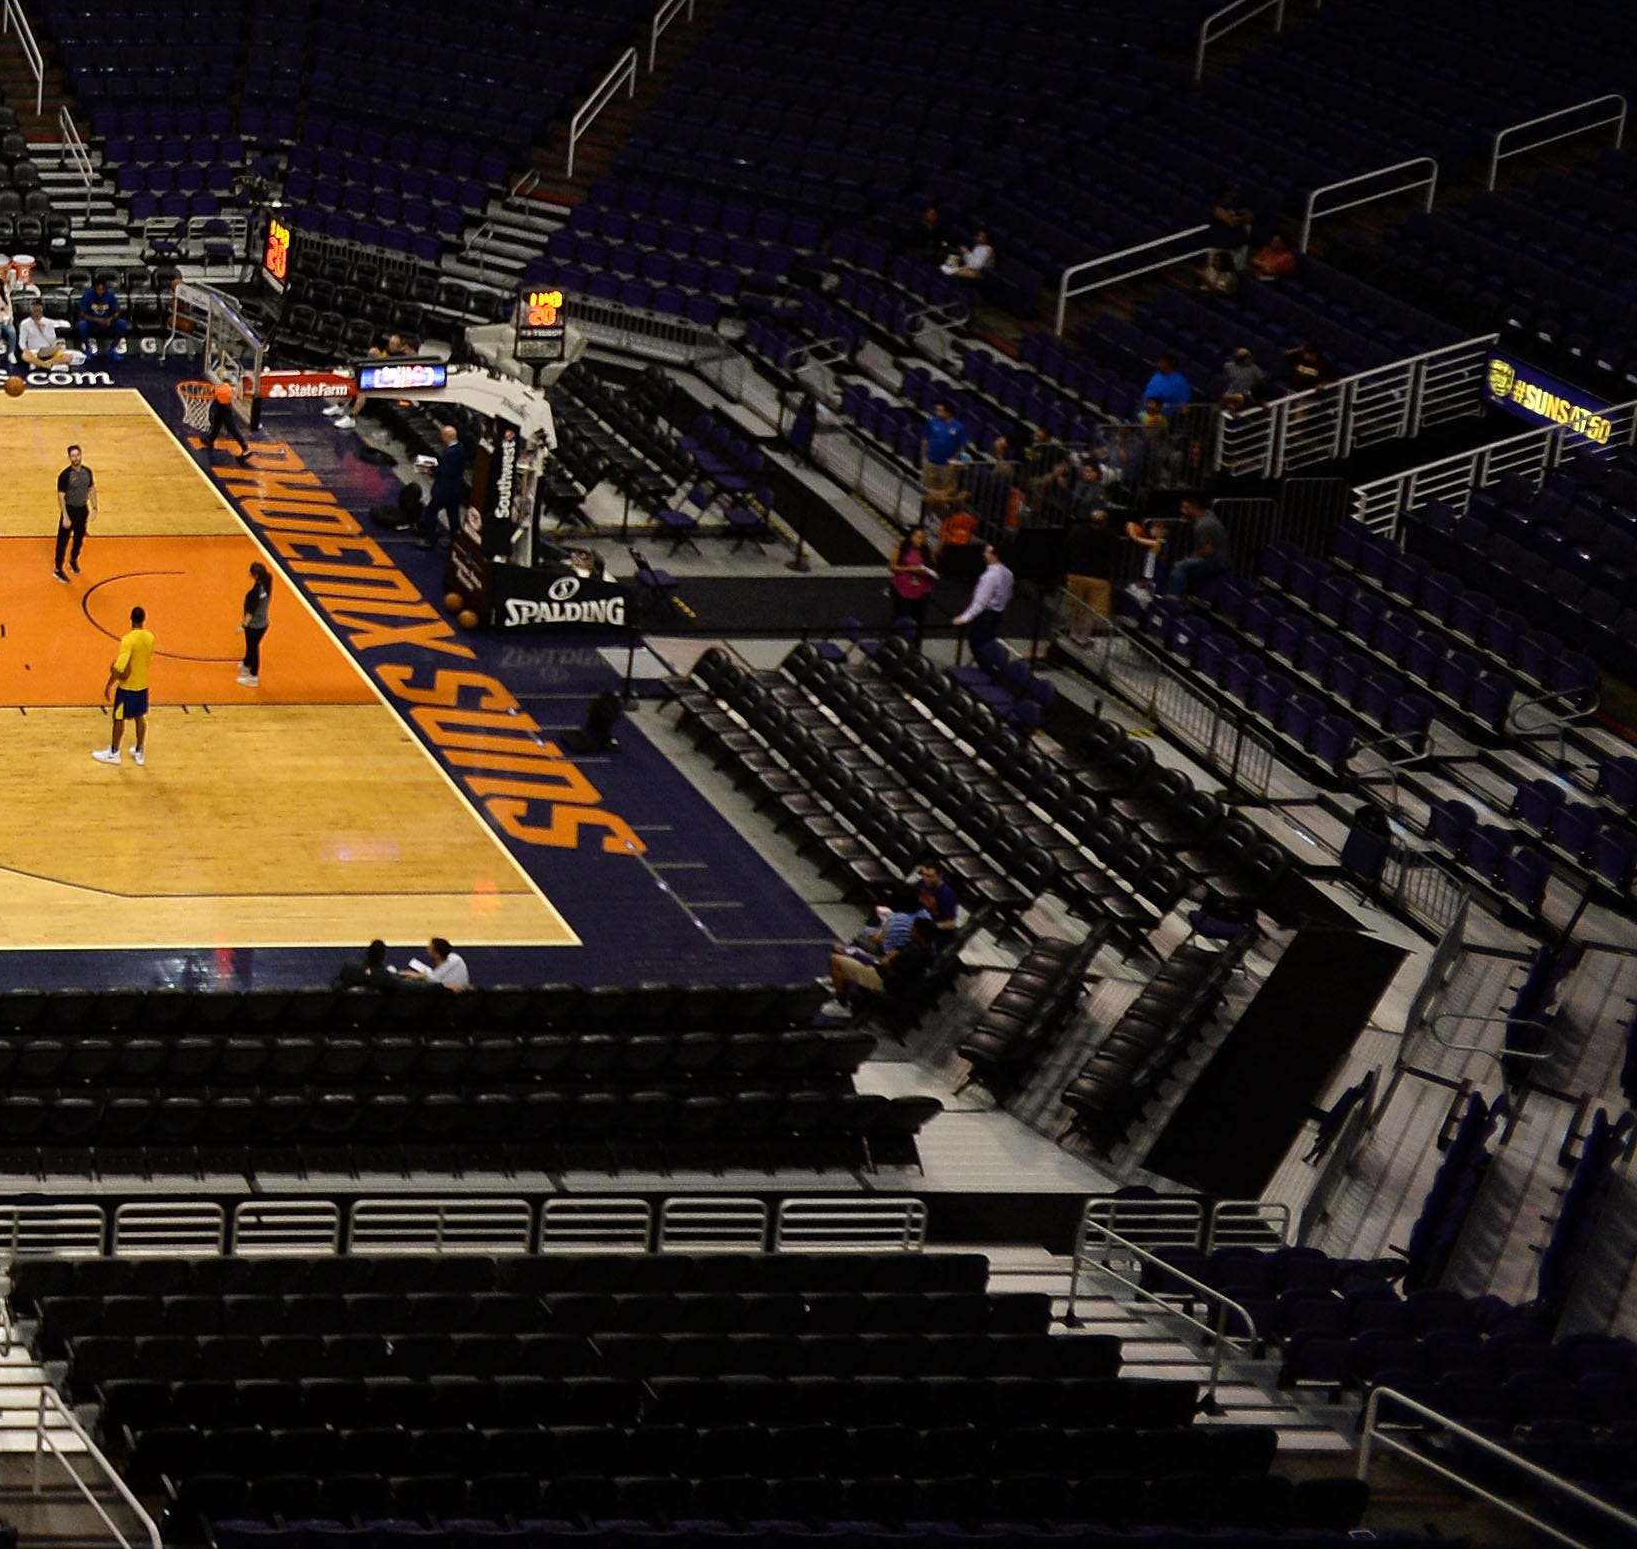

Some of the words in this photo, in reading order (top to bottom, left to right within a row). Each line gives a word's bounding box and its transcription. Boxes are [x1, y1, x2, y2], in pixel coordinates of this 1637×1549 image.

[287, 384, 348, 398] StateFarm
[494, 440, 516, 518] Southwest
[505, 597, 625, 627] SPALDING
[375, 663, 648, 856] SUNS
